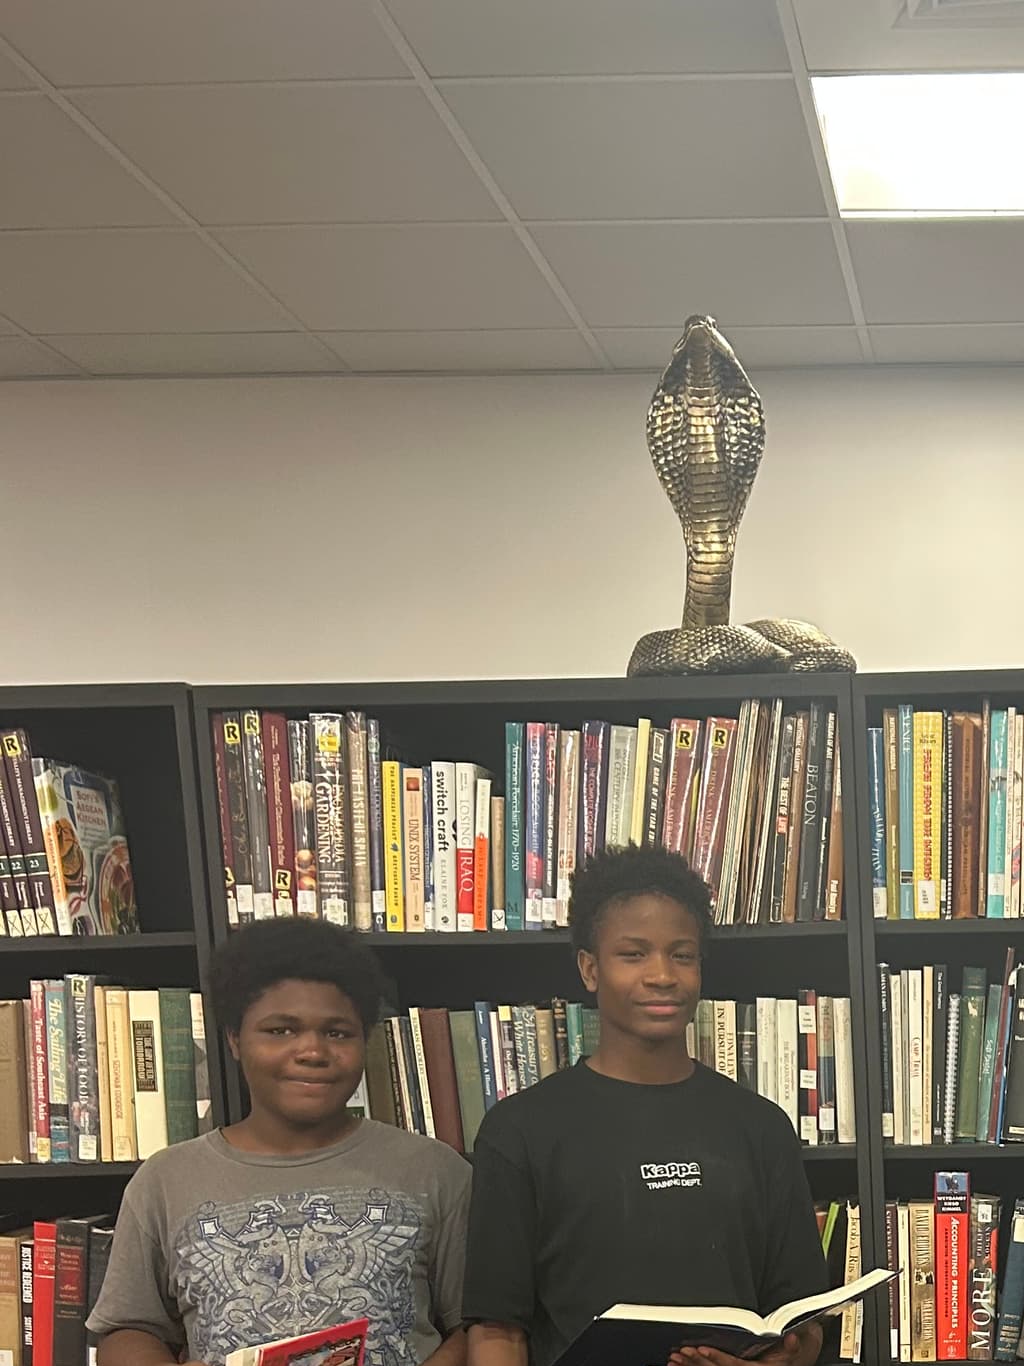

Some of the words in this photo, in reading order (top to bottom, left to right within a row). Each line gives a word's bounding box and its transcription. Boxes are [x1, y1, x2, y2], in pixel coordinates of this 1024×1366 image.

[6, 738, 17, 750] R
[227, 725, 237, 740] R
[679, 730, 690, 746] R
[715, 730, 725, 745] R
[436, 771, 448, 815] switch
[779, 789, 788, 806] BEST
[804, 763, 819, 826] BEATON
[316, 782, 331, 864] GARDENING
[409, 819, 419, 842] UNIX
[437, 819, 450, 852] craft
[460, 800, 472, 846] LOSING
[777, 816, 786, 834] LIFE
[12, 861, 21, 870] 22
[30, 859, 39, 868] 23
[410, 843, 420, 881] SYSTEM
[460, 850, 474, 896] IRAQ
[277, 872, 290, 885] R
[73, 979, 84, 992] R
[33, 1018, 43, 1042] Taste
[49, 1027, 65, 1072] Sailing
[525, 1027, 537, 1070] Treasury
[35, 1057, 47, 1100] Southeast
[78, 1067, 89, 1105] FOOD
[38, 1102, 47, 1121] Asia
[641, 1162, 700, 1179] Kappa
[950, 1216, 960, 1276] ACCOUNTING
[950, 1279, 959, 1329] PRINCIPLES
[971, 1269, 992, 1351] MORE
